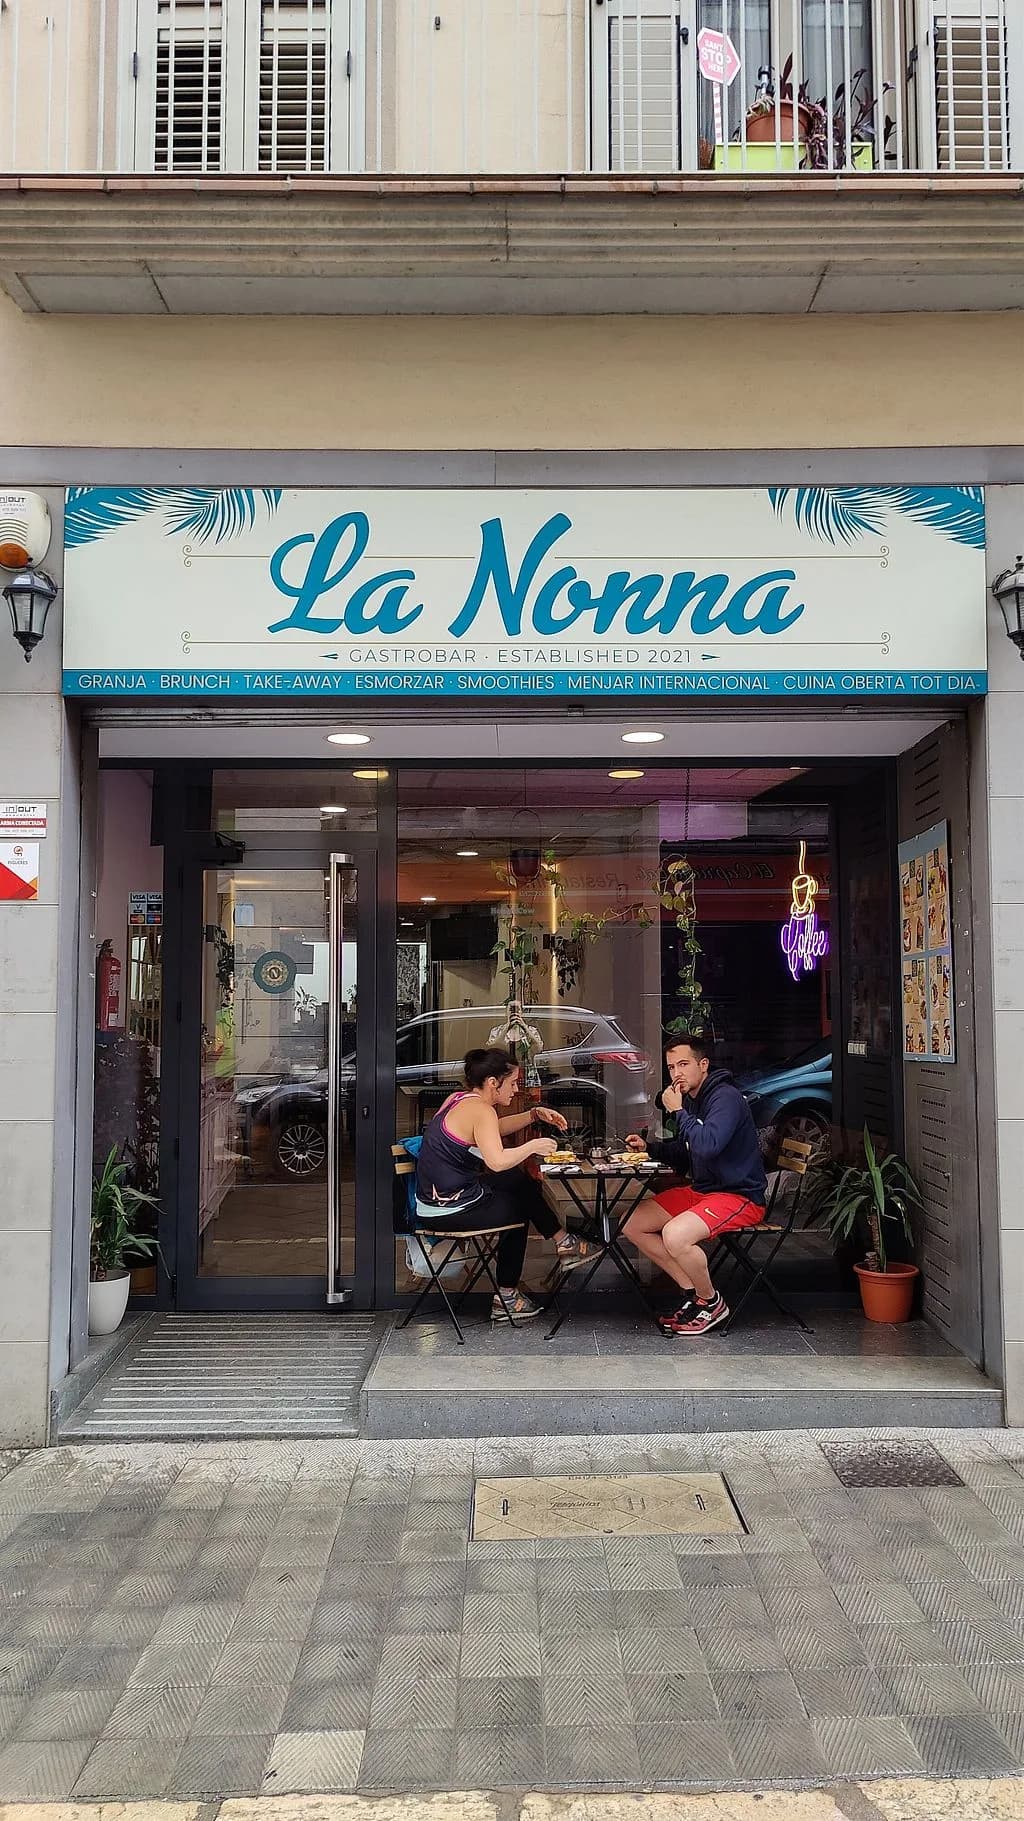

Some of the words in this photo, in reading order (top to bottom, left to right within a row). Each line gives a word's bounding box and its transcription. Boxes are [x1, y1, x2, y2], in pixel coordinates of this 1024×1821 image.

[268, 511, 423, 635] La
[447, 511, 805, 638] Nonna
[349, 649, 476, 663] GASTROBAR
[498, 649, 640, 663] ESTABLISHED
[648, 649, 690, 663] 2021
[78, 674, 147, 689] GRANJA
[160, 674, 230, 689] BRUNCH
[243, 674, 342, 689] TAKE-AWAY
[355, 675, 445, 690] ESMORZAR
[457, 675, 555, 690] SMOOTHIES
[568, 675, 634, 690] MENJAR
[639, 675, 770, 690] INTERNACIONAL
[783, 675, 836, 690] CUINA
[841, 675, 906, 690] OBERTA
[910, 675, 943, 690] TOT
[948, 675, 976, 690] DIA
[780, 911, 827, 981] Coffee
